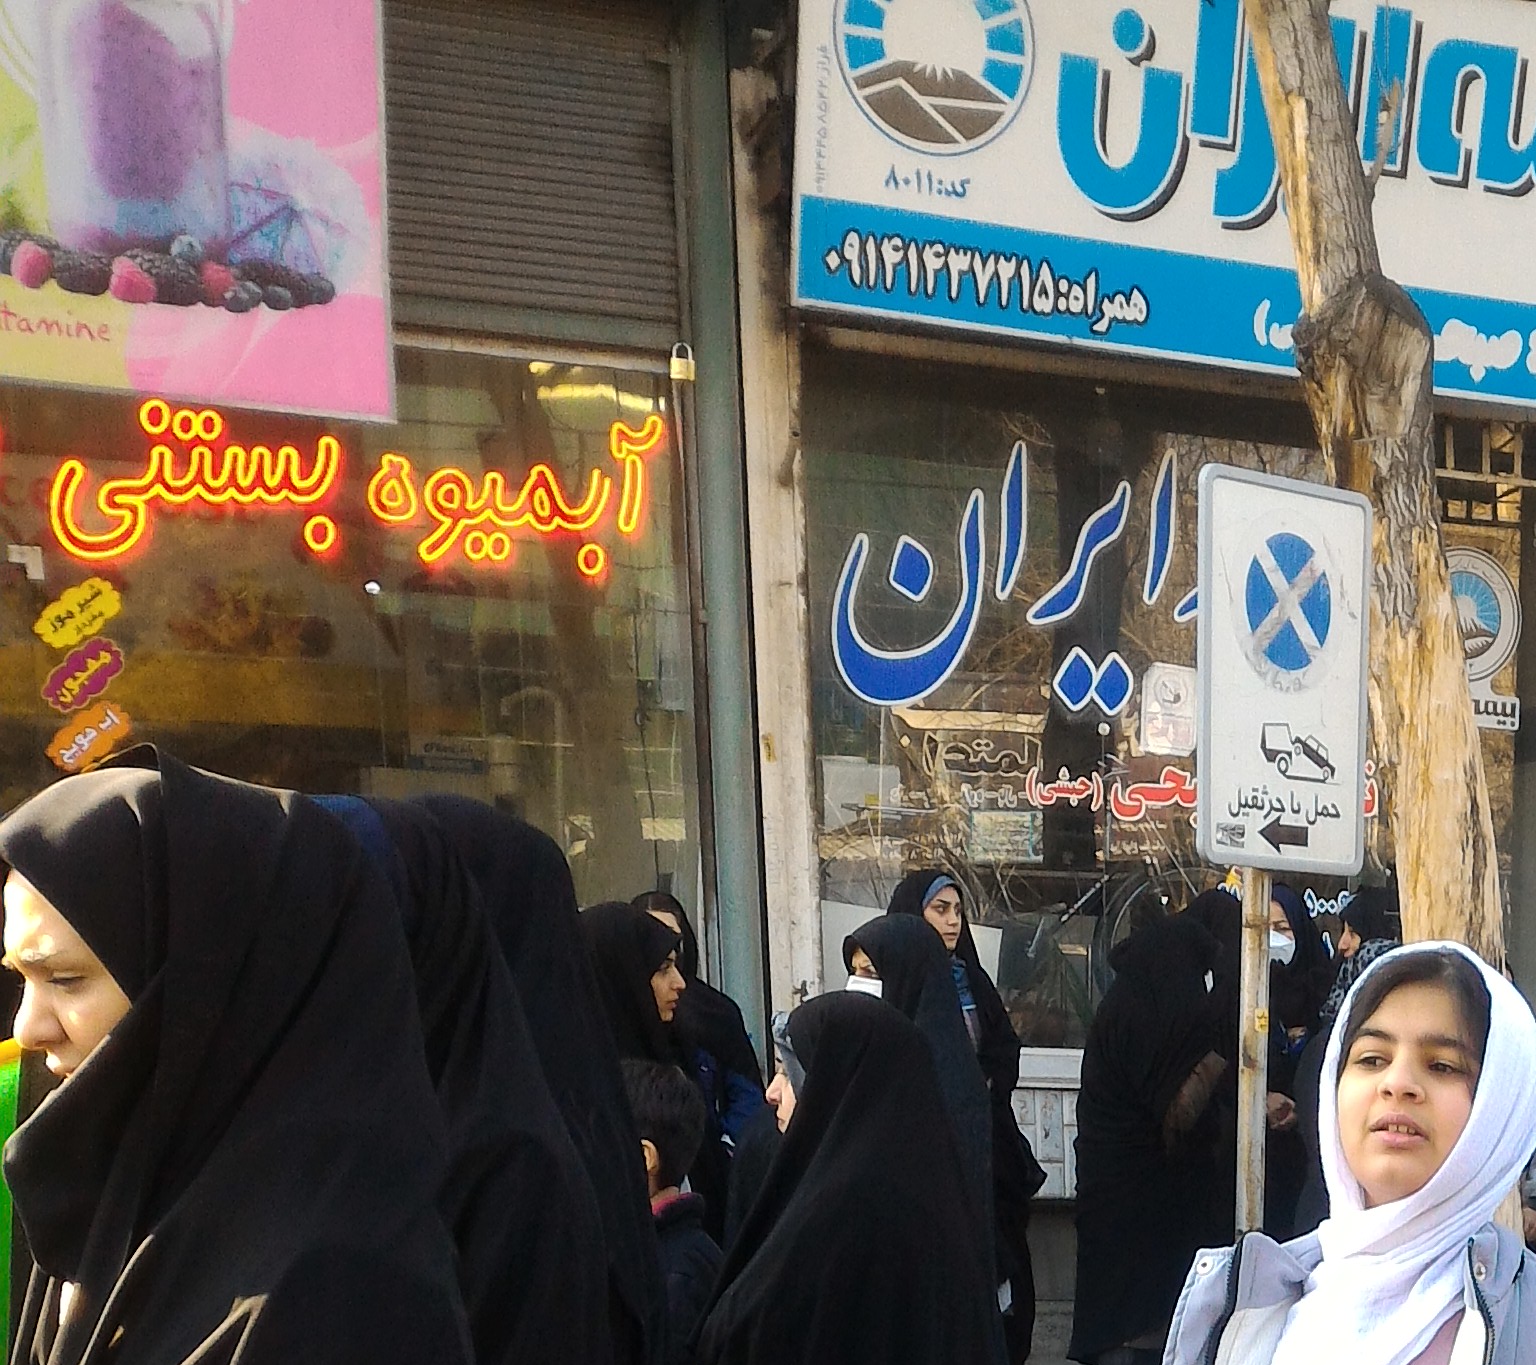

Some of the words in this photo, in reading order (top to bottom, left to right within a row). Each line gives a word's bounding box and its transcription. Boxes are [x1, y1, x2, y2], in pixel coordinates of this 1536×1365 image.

[50, 398, 342, 560] بستنی
[366, 414, 663, 576] آبمیوه
[832, 438, 1177, 717] ایران
[1305, 793, 1341, 825] حمل
